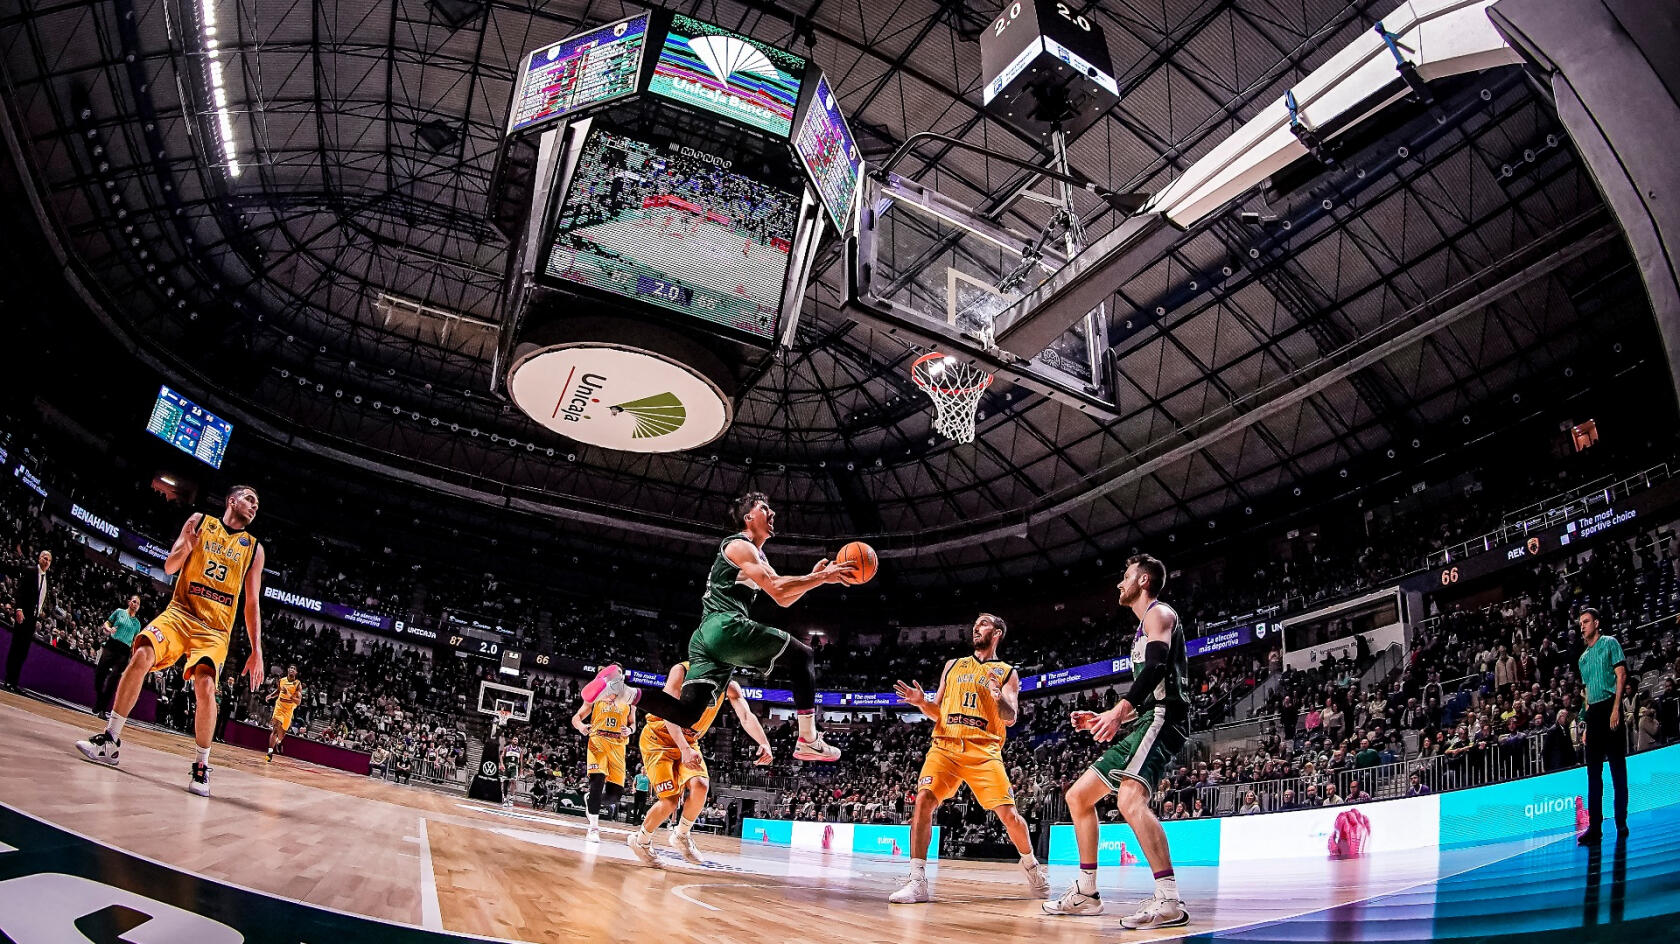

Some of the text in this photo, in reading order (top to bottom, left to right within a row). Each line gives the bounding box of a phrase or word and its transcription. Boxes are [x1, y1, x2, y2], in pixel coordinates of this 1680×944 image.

[995, 3, 1021, 37] 2.0
[1056, 2, 1091, 32] 2.0
[673, 77, 773, 119] Unicaja Banco
[681, 147, 733, 169] MONDO
[653, 281, 680, 300] 2.0
[561, 373, 607, 422] Unicaja
[71, 503, 120, 538] BENAHAVIS
[1579, 508, 1613, 528] The most
[1581, 520, 1612, 538] sportive
[1612, 510, 1636, 525] choice
[1507, 547, 1525, 559] AEK
[204, 560, 228, 583] 23
[1441, 567, 1459, 586] 66
[264, 586, 322, 612] BENAHAVIS
[407, 626, 437, 639] UNICAJA
[449, 635, 464, 647] 87
[1207, 631, 1239, 645] La elección
[479, 641, 498, 655] 2.0
[1198, 638, 1239, 654] más deportiva
[536, 654, 549, 666] 66
[633, 671, 643, 679] The
[963, 691, 977, 709] 11
[606, 716, 617, 727] 19
